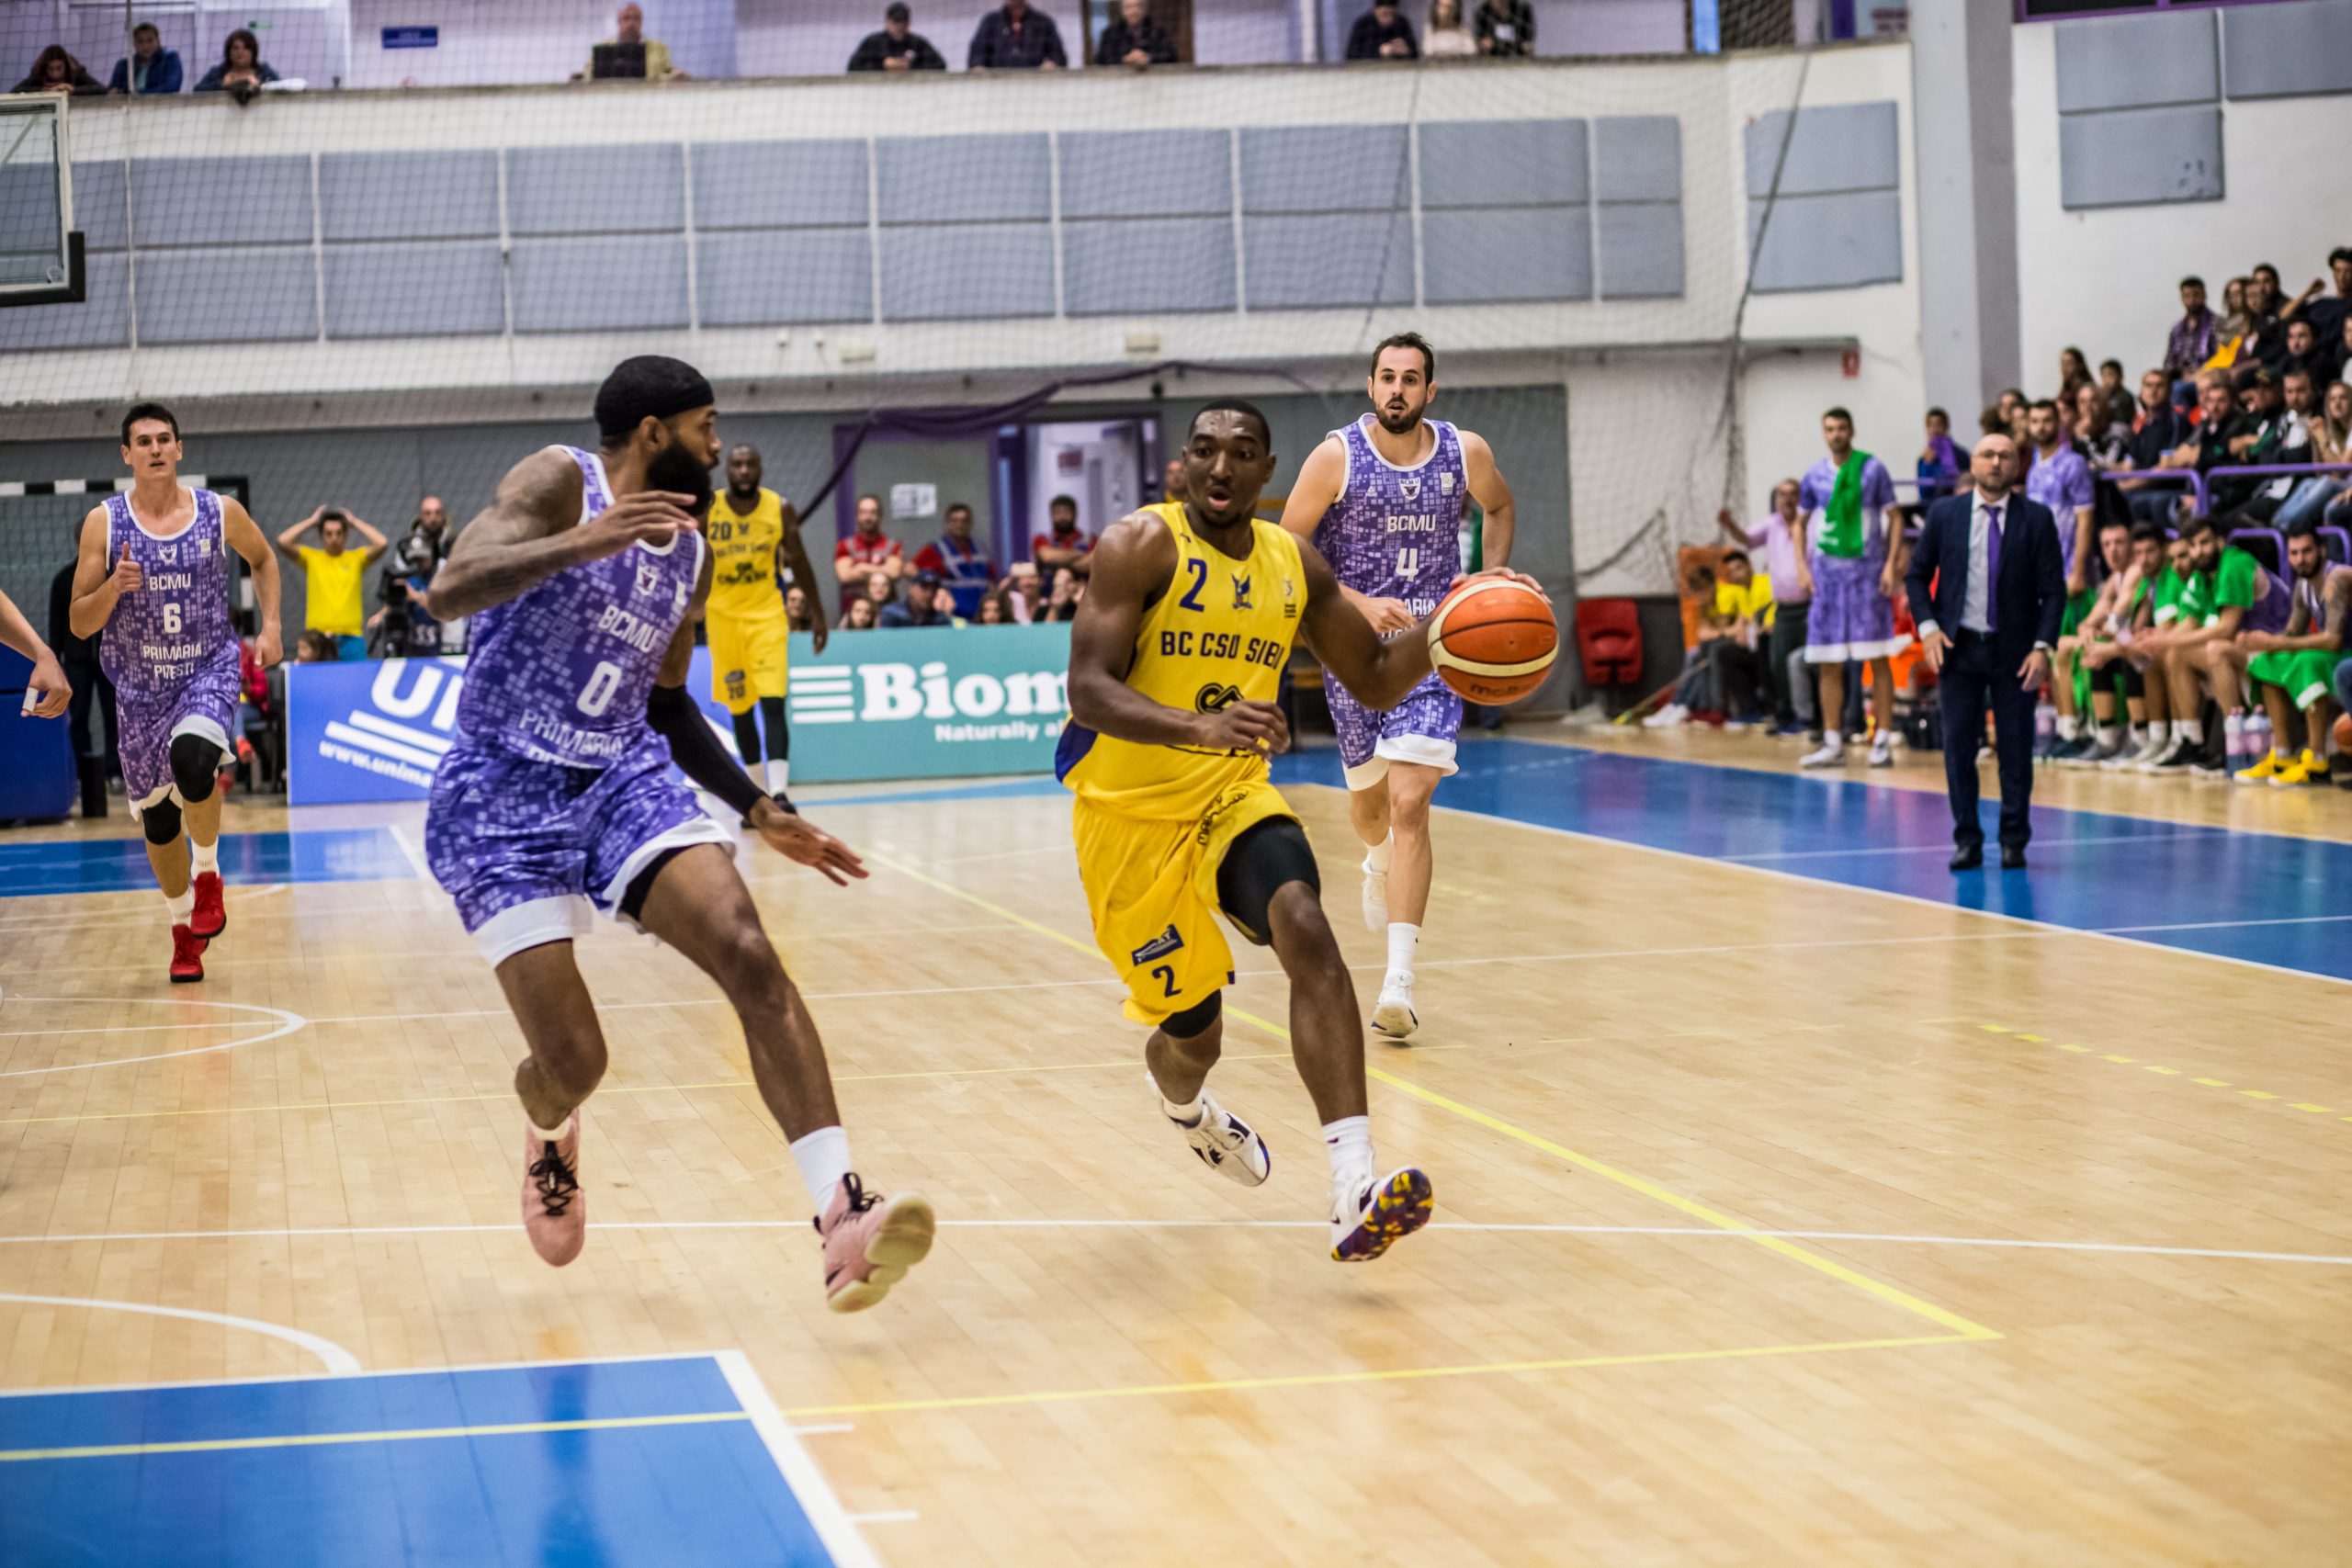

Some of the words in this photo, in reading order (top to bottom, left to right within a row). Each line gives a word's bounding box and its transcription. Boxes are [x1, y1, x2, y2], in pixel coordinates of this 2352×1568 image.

[710, 521, 732, 541] 20
[1386, 513, 1437, 533] BCMU
[1396, 547, 1419, 582] 4
[150, 573, 191, 591] BCMU
[1178, 557, 1207, 613] 2
[164, 603, 182, 634] 6
[598, 604, 660, 653] BCMU
[142, 643, 202, 661] PRIMARIA
[1160, 630, 1193, 656] BC
[1200, 632, 1240, 660] CSU
[576, 660, 622, 717] 0
[934, 720, 1039, 742] Naturally
[1151, 964, 1182, 998] 2
